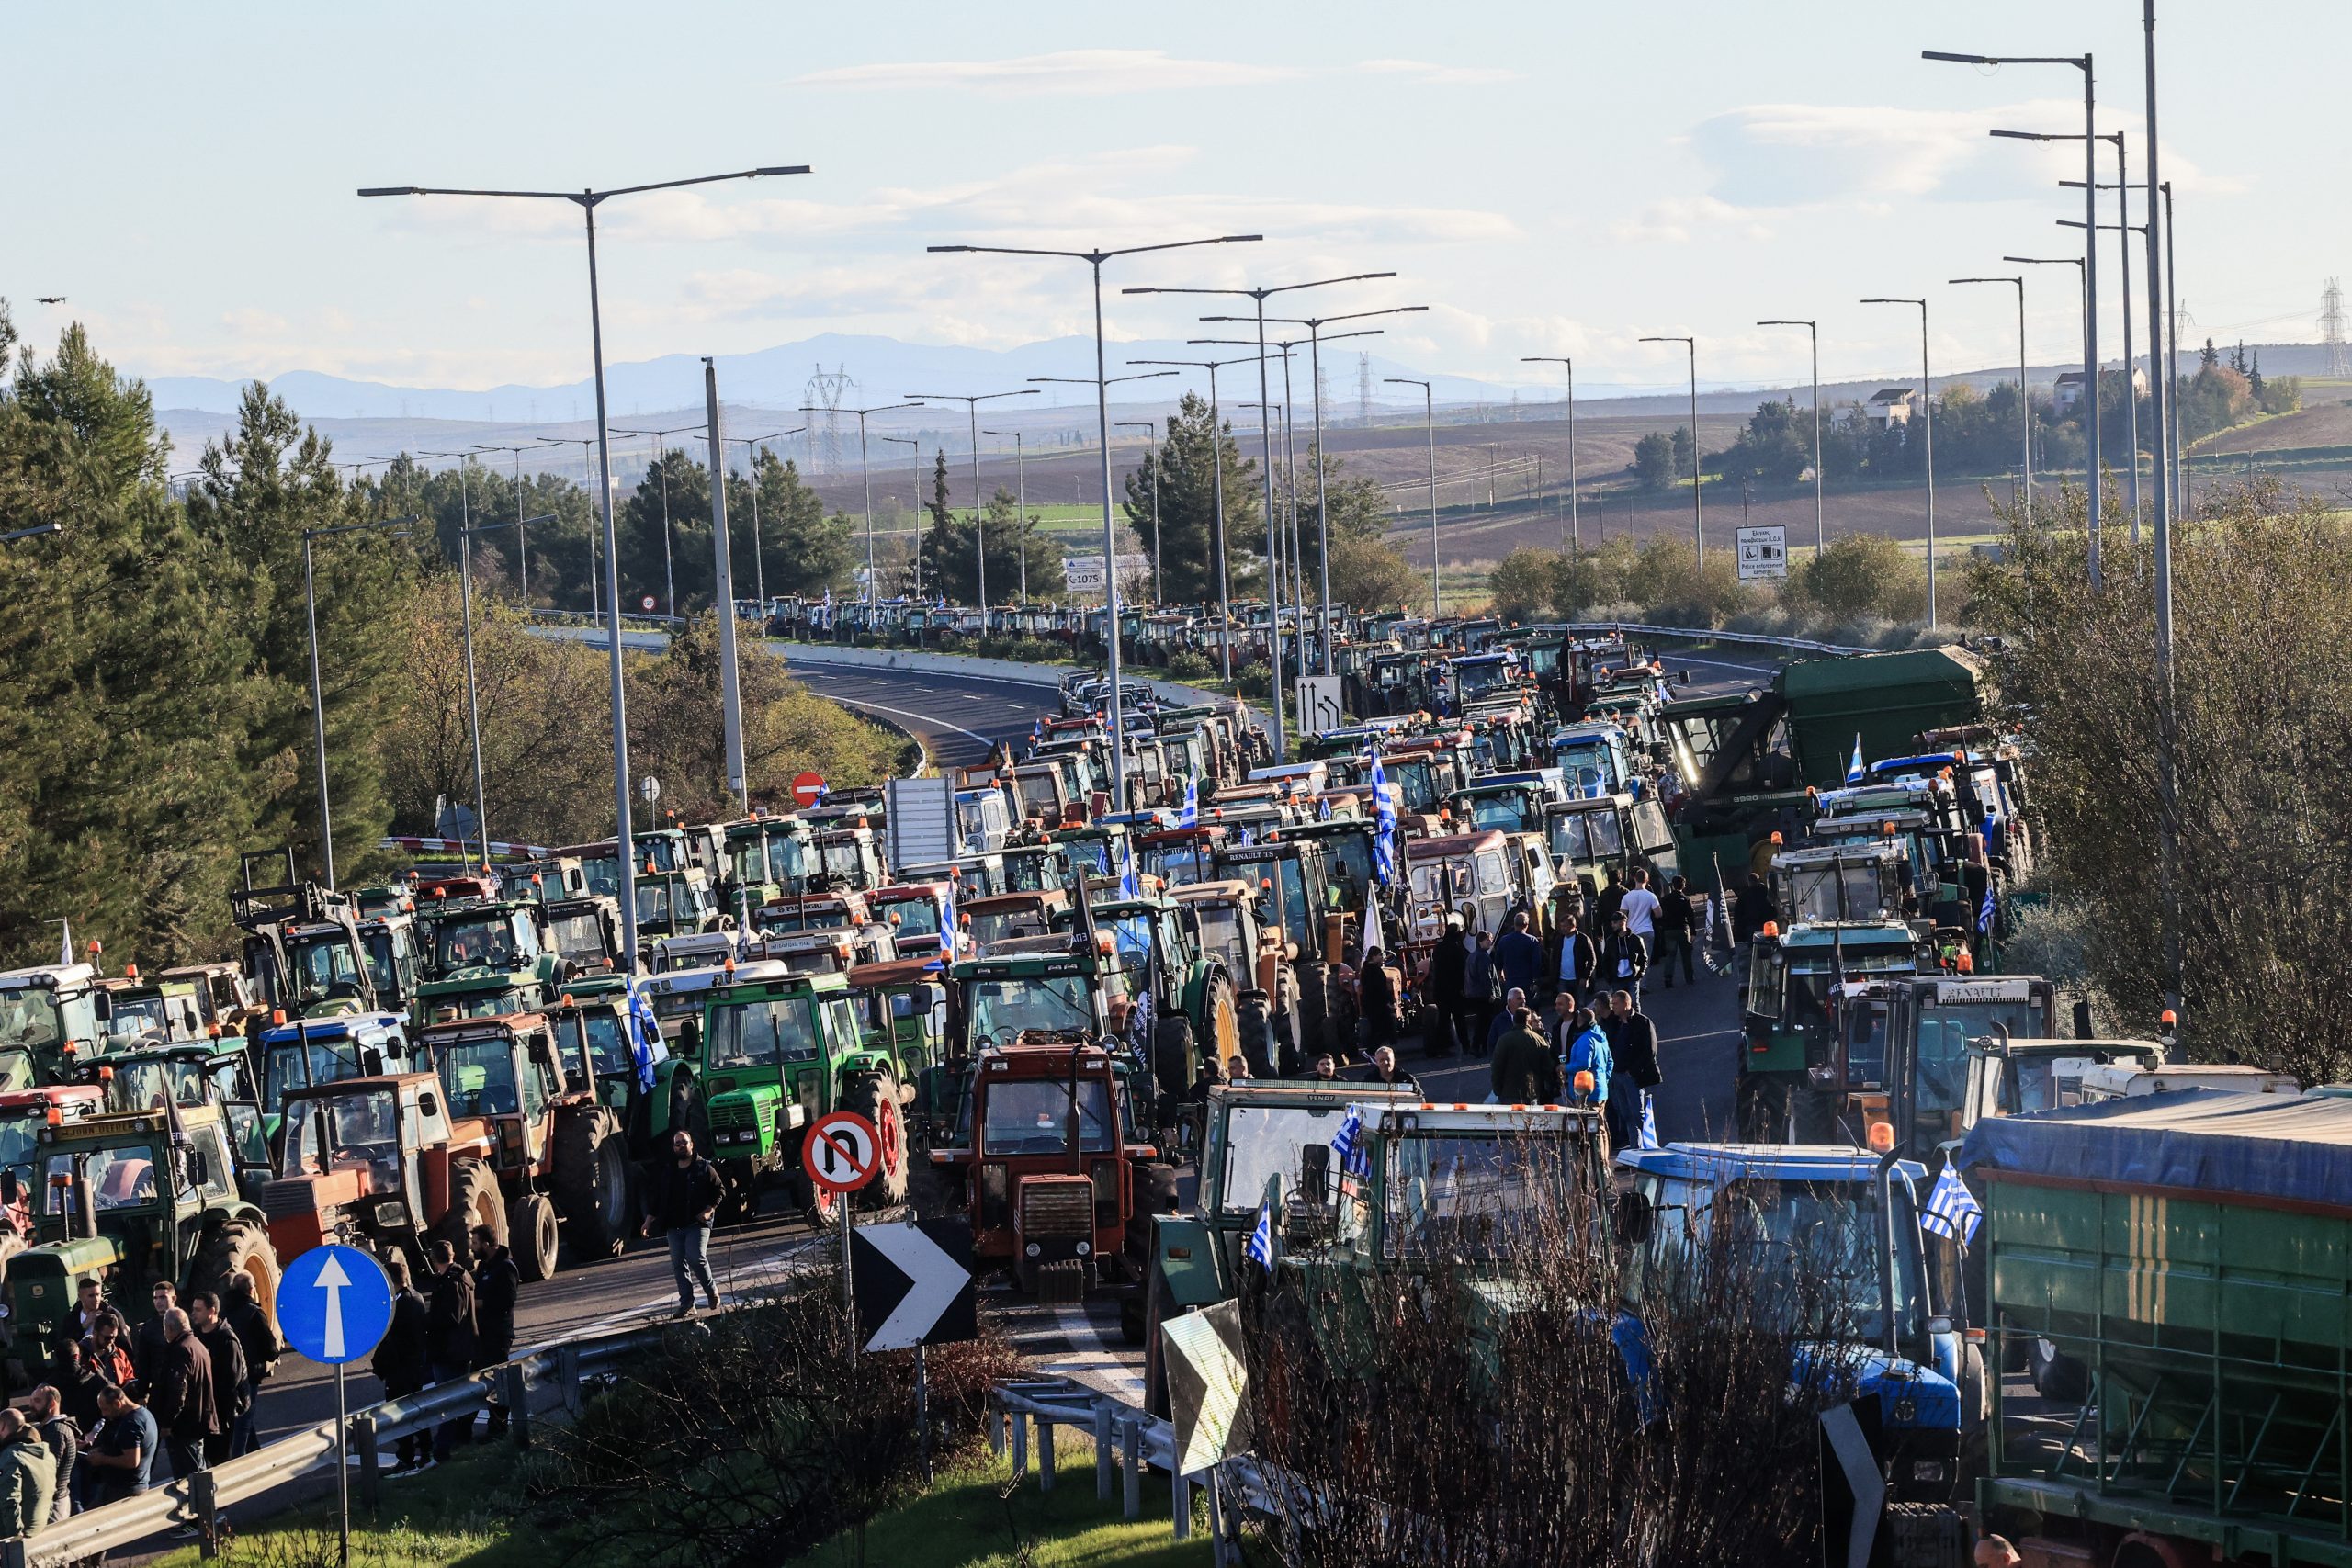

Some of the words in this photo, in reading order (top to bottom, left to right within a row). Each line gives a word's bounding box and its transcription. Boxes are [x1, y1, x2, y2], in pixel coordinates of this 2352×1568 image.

[1077, 574, 1100, 584] 1075
[1229, 852, 1262, 861] RENAULT
[1947, 987, 2003, 999] RENAULT
[71, 1126, 95, 1136] JOHN
[98, 1122, 128, 1133] DEERE
